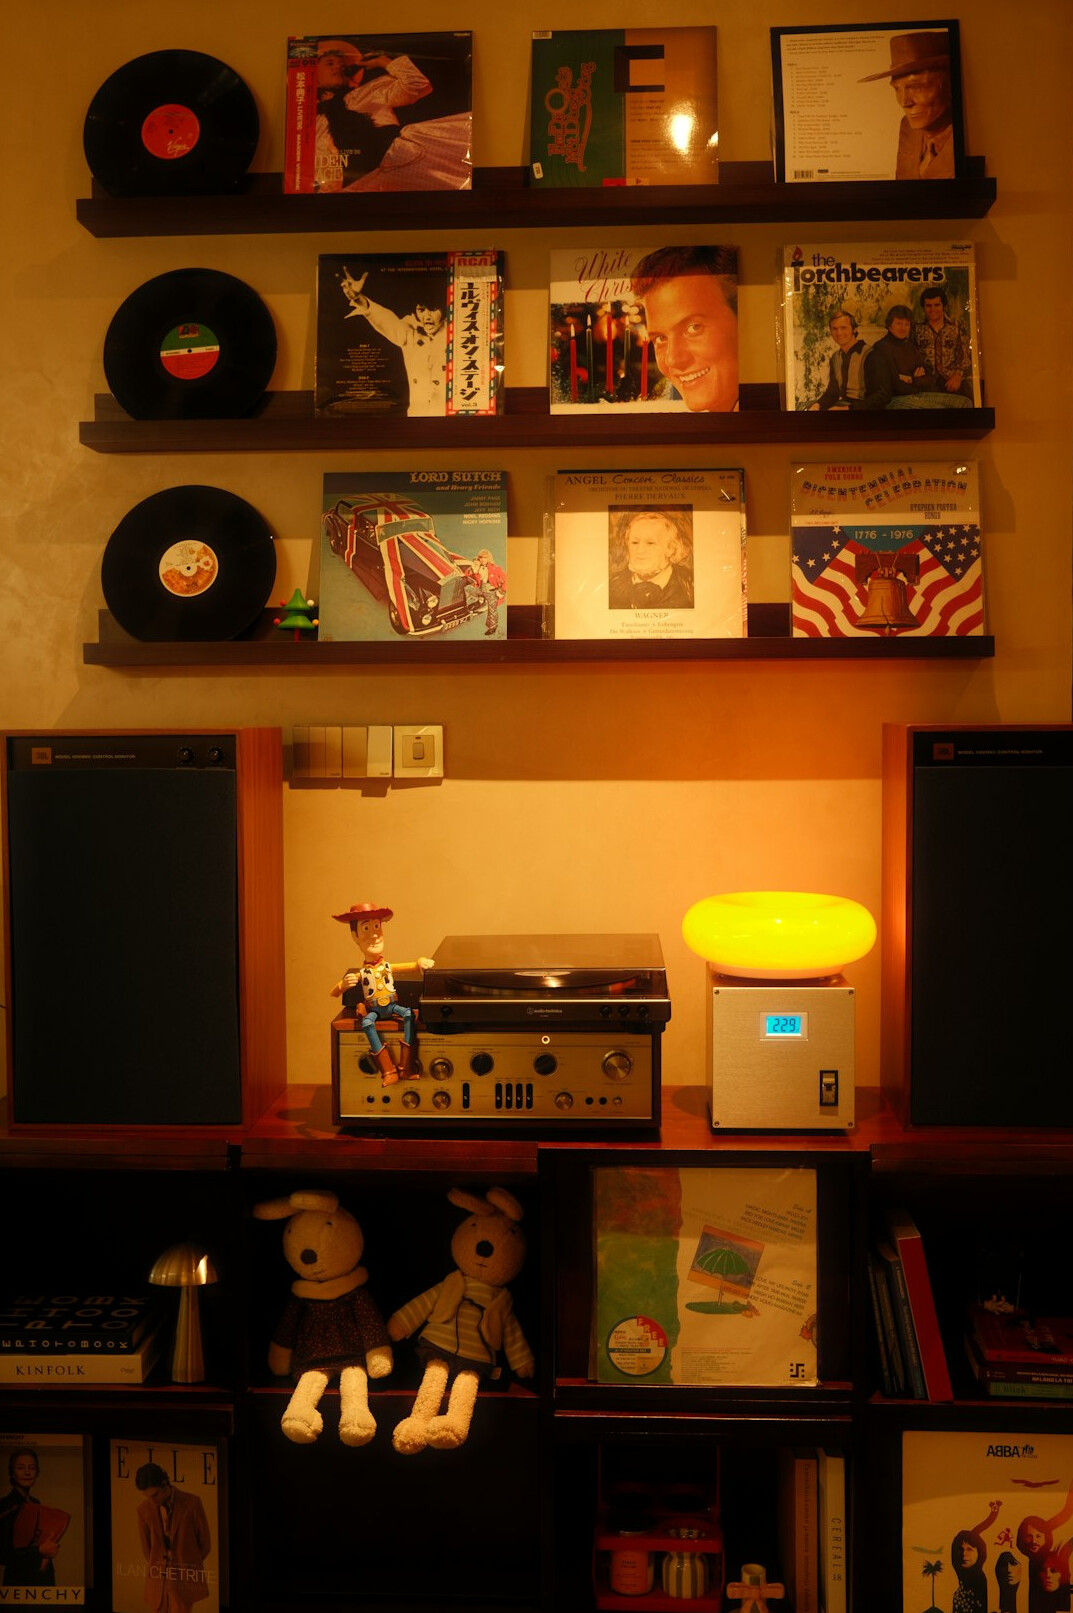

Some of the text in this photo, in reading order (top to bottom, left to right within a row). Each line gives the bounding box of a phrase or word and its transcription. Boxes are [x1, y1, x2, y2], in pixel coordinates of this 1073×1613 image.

[458, 258, 488, 266] RCA
[813, 253, 835, 266] the
[573, 250, 631, 284] White
[410, 472, 501, 483] LORD SUTCH
[565, 473, 705, 485] ANGEL Concert Classics
[801, 466, 913, 500] BICENTENNIAL
[864, 478, 968, 509] CELEBRATION
[909, 503, 936, 512] STEPHEN
[924, 511, 941, 519] SONGS
[854, 530, 877, 540] 1776
[889, 530, 914, 540] 1976
[773, 1018, 796, 1032] 229
[16, 1365, 86, 1376] KINFOLK
[987, 1445, 1020, 1458] ABBA
[832, 1518, 843, 1568] CEREAL
[117, 1563, 147, 1578] ILAN
